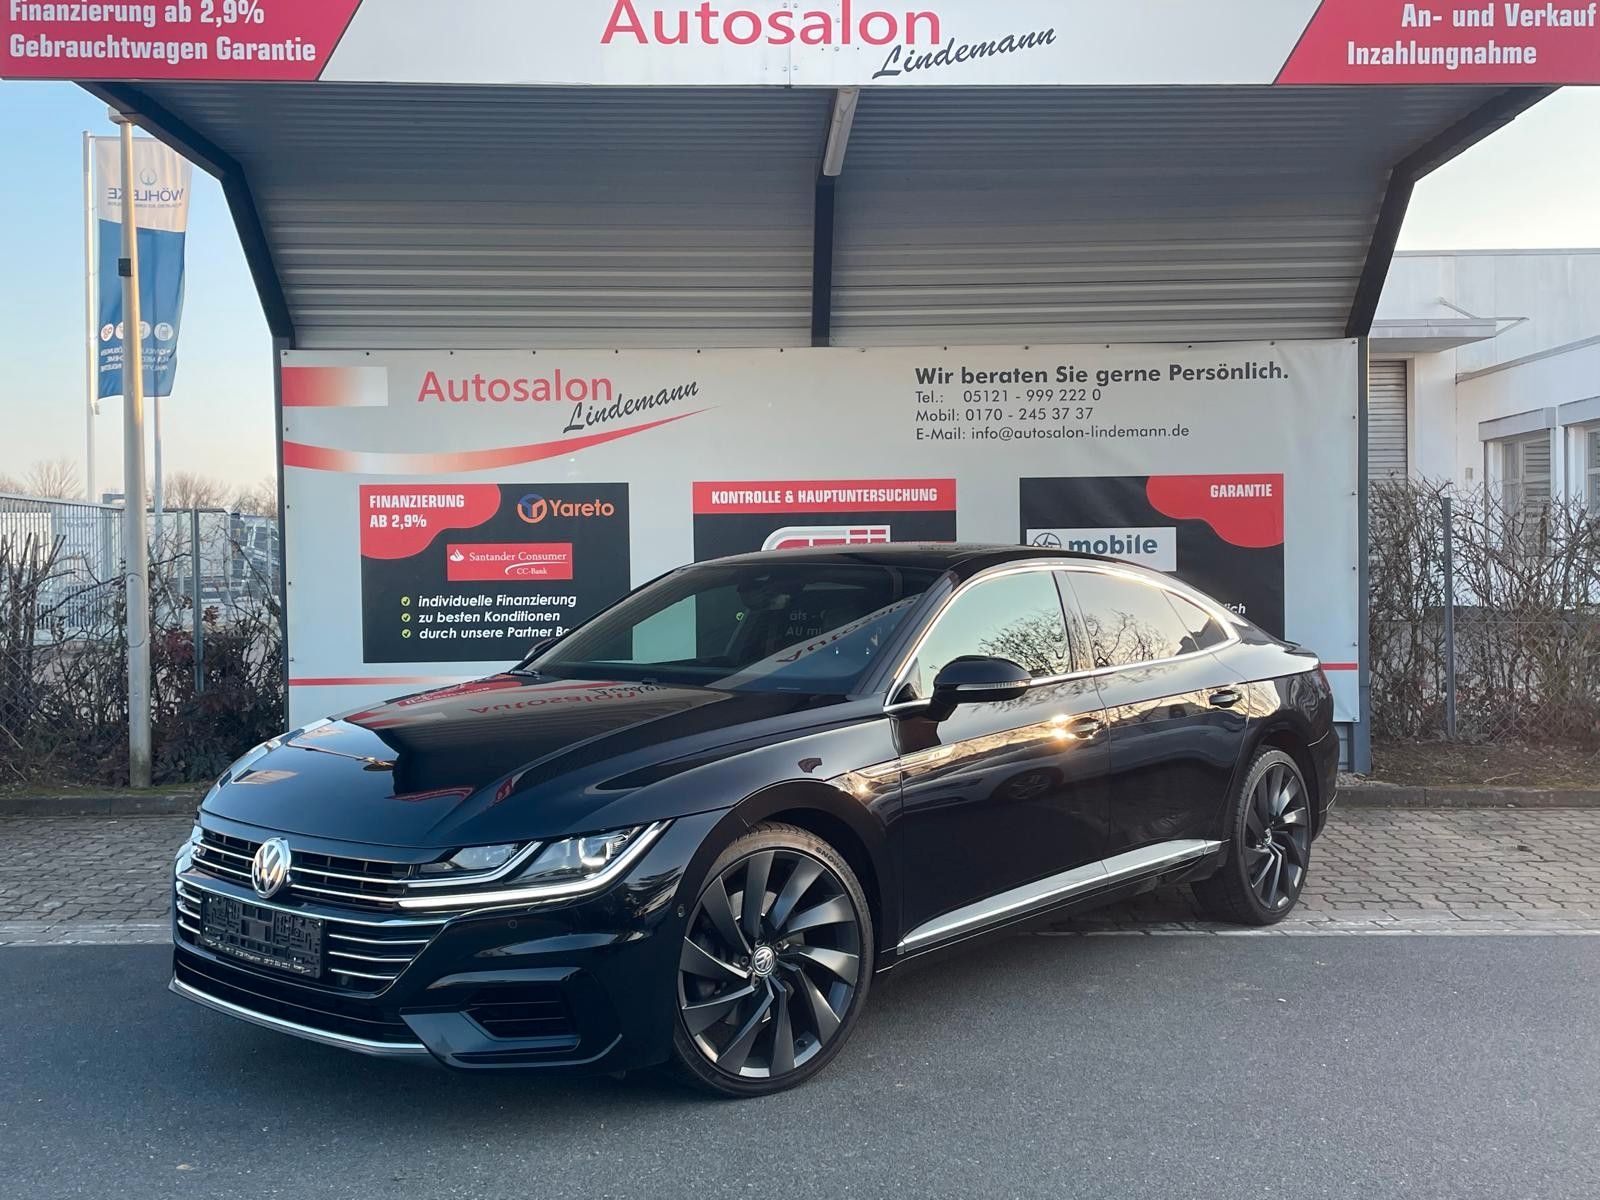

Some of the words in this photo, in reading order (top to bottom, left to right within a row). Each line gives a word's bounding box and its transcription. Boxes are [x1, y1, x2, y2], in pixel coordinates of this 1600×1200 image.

[10, 0, 156, 28] Finanzierung
[164, 1, 192, 23] ab
[200, 0, 265, 28] 2,9%
[600, 0, 940, 45] Autosalon
[1401, 3, 1442, 28] An-
[1452, 3, 1495, 27] und
[1504, 2, 1597, 27] Verkauf
[9, 34, 208, 65] Gebrauchtwagen
[216, 36, 316, 62] Garantie
[872, 26, 1057, 79] Lindemann
[1347, 40, 1537, 70] Inzahlungnahme
[915, 367, 954, 385] Wir
[961, 366, 1048, 385] beraten
[1056, 366, 1088, 383] Sie
[1096, 368, 1161, 387] gerne
[1169, 361, 1289, 383] Persönlich.
[418, 368, 612, 403] Autosalon
[915, 390, 944, 404] Tel.:
[963, 389, 1009, 403] 05121
[1026, 388, 1053, 403] 999
[1059, 388, 1087, 403] 222
[1092, 388, 1101, 402] 0
[563, 380, 699, 434] Lindemann
[915, 408, 960, 422] Mobil:
[965, 408, 1003, 422] 0170
[1018, 407, 1047, 421] 245
[1052, 407, 1070, 421] 37
[1075, 407, 1093, 420] 37
[916, 426, 966, 441] E-Mail:
[971, 424, 1190, 442] info@autosalon-lindemann.de
[711, 490, 781, 504] KONTROLLE
[785, 490, 794, 504] &
[798, 488, 938, 503] HAUPTUNTERSUCHUNG
[1210, 483, 1273, 498] GARANTIE
[369, 494, 465, 508] FINANZIERUNG
[548, 498, 615, 517] Yareto
[369, 515, 387, 528] AB
[391, 514, 427, 529] 2,9%
[1068, 534, 1158, 554] mobile
[469, 551, 516, 562] Santander
[518, 551, 567, 561] Consumer
[516, 567, 548, 576] CC-Bank
[418, 595, 493, 608] individuelle
[496, 594, 577, 608] Finanzierung
[418, 614, 434, 623] zu
[437, 611, 480, 623] besten
[484, 610, 560, 622] Konditionen
[419, 626, 456, 639] durch
[460, 629, 503, 638] unsere
[507, 626, 552, 638] Partner
